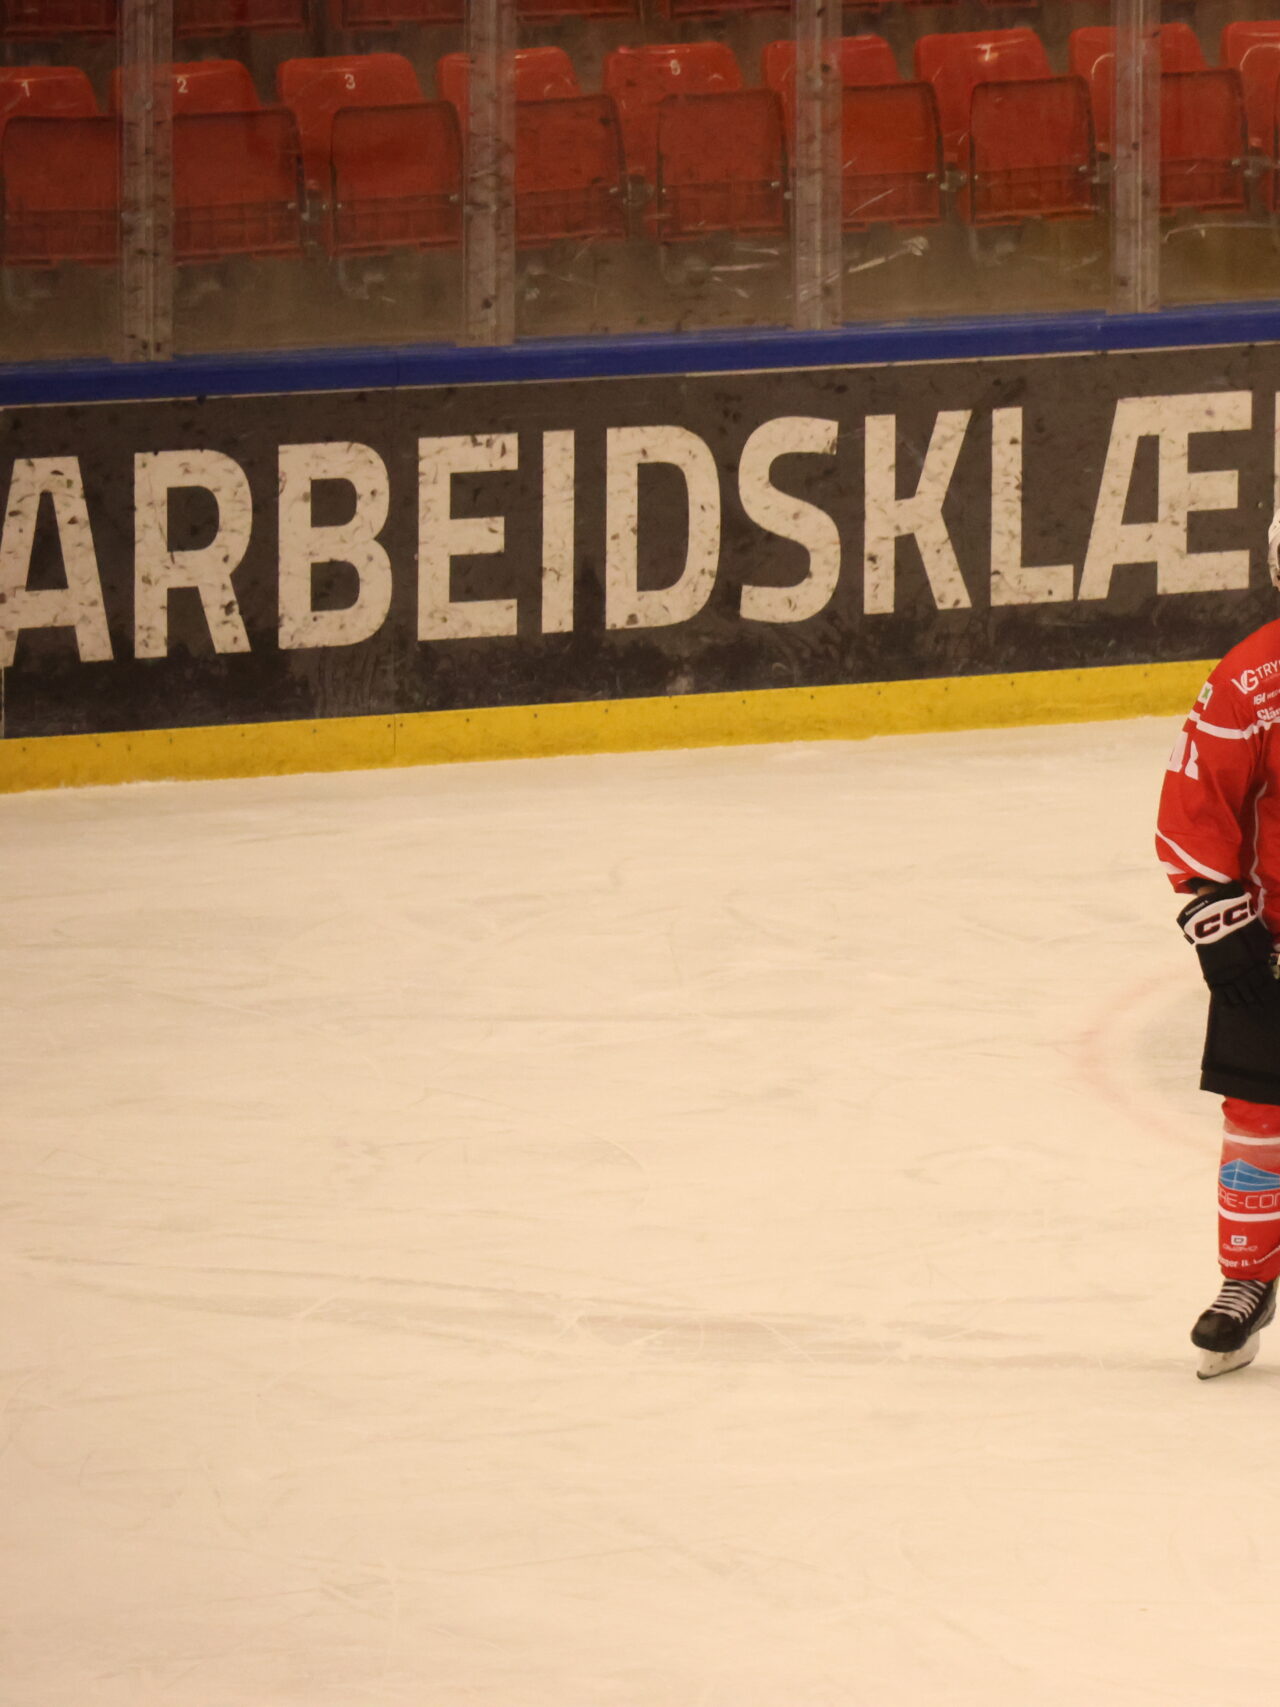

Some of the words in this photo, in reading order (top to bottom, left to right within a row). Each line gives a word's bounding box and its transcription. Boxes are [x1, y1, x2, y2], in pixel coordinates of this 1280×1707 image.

[20, 80, 31, 98] 1
[176, 76, 189, 94] 2
[344, 73, 356, 90] 3
[1231, 669, 1260, 695] VG
[1194, 899, 1256, 939] CC
